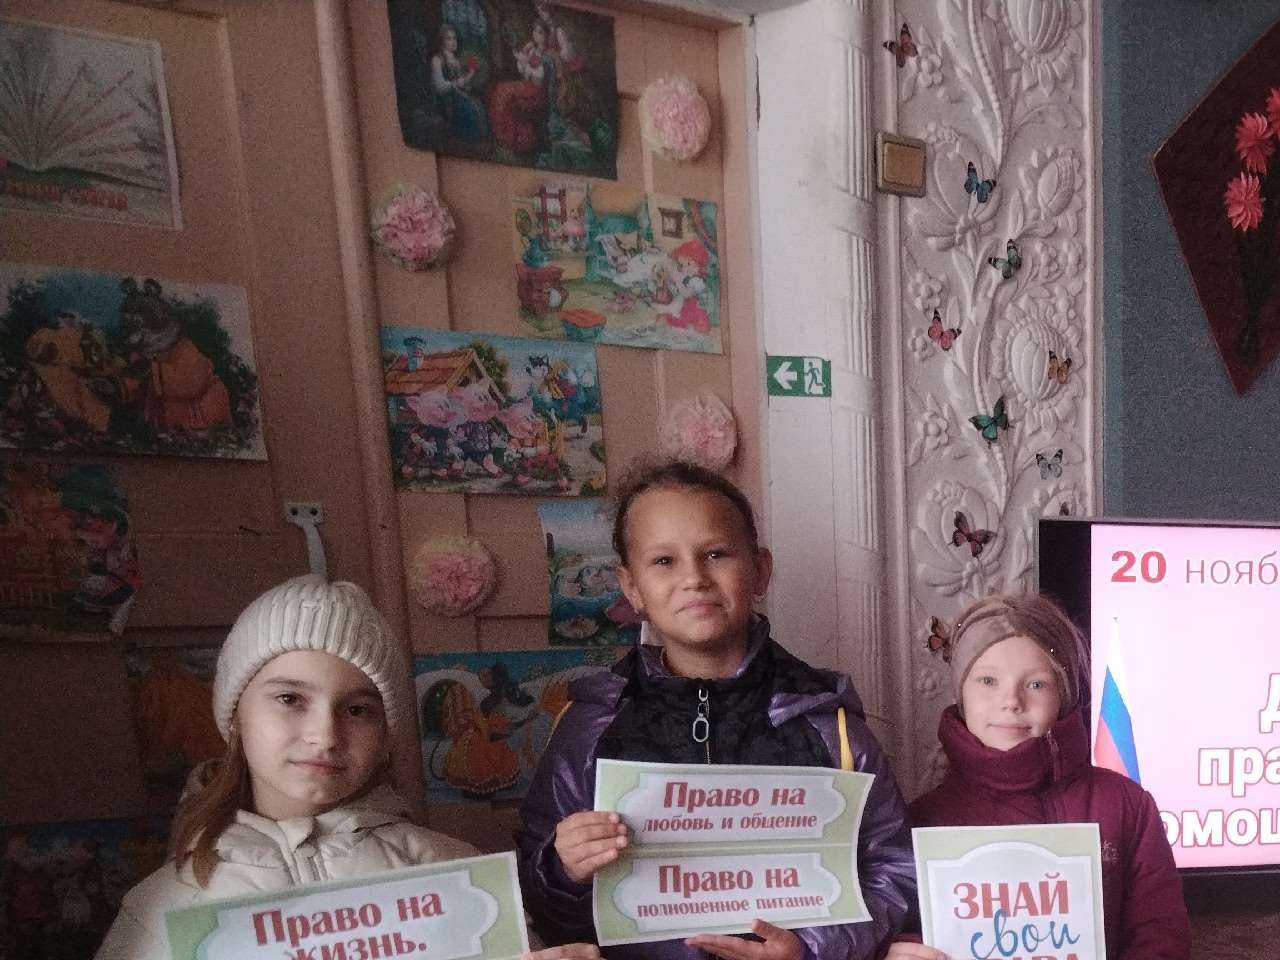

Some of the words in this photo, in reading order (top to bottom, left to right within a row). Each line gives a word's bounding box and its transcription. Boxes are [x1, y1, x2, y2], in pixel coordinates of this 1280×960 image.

[1111, 550, 1166, 583] 20
[664, 781, 760, 813] Право
[771, 787, 806, 806] на
[642, 815, 713, 833] любовь
[721, 816, 733, 829] и
[740, 812, 817, 830] общение
[659, 865, 753, 898] Право
[765, 867, 801, 888] на
[953, 872, 1069, 920] ЗНАЙ
[252, 900, 383, 947] Право
[397, 892, 445, 921] на
[637, 899, 750, 917] полноценное
[756, 895, 824, 910] питание
[970, 909, 1080, 960] свои
